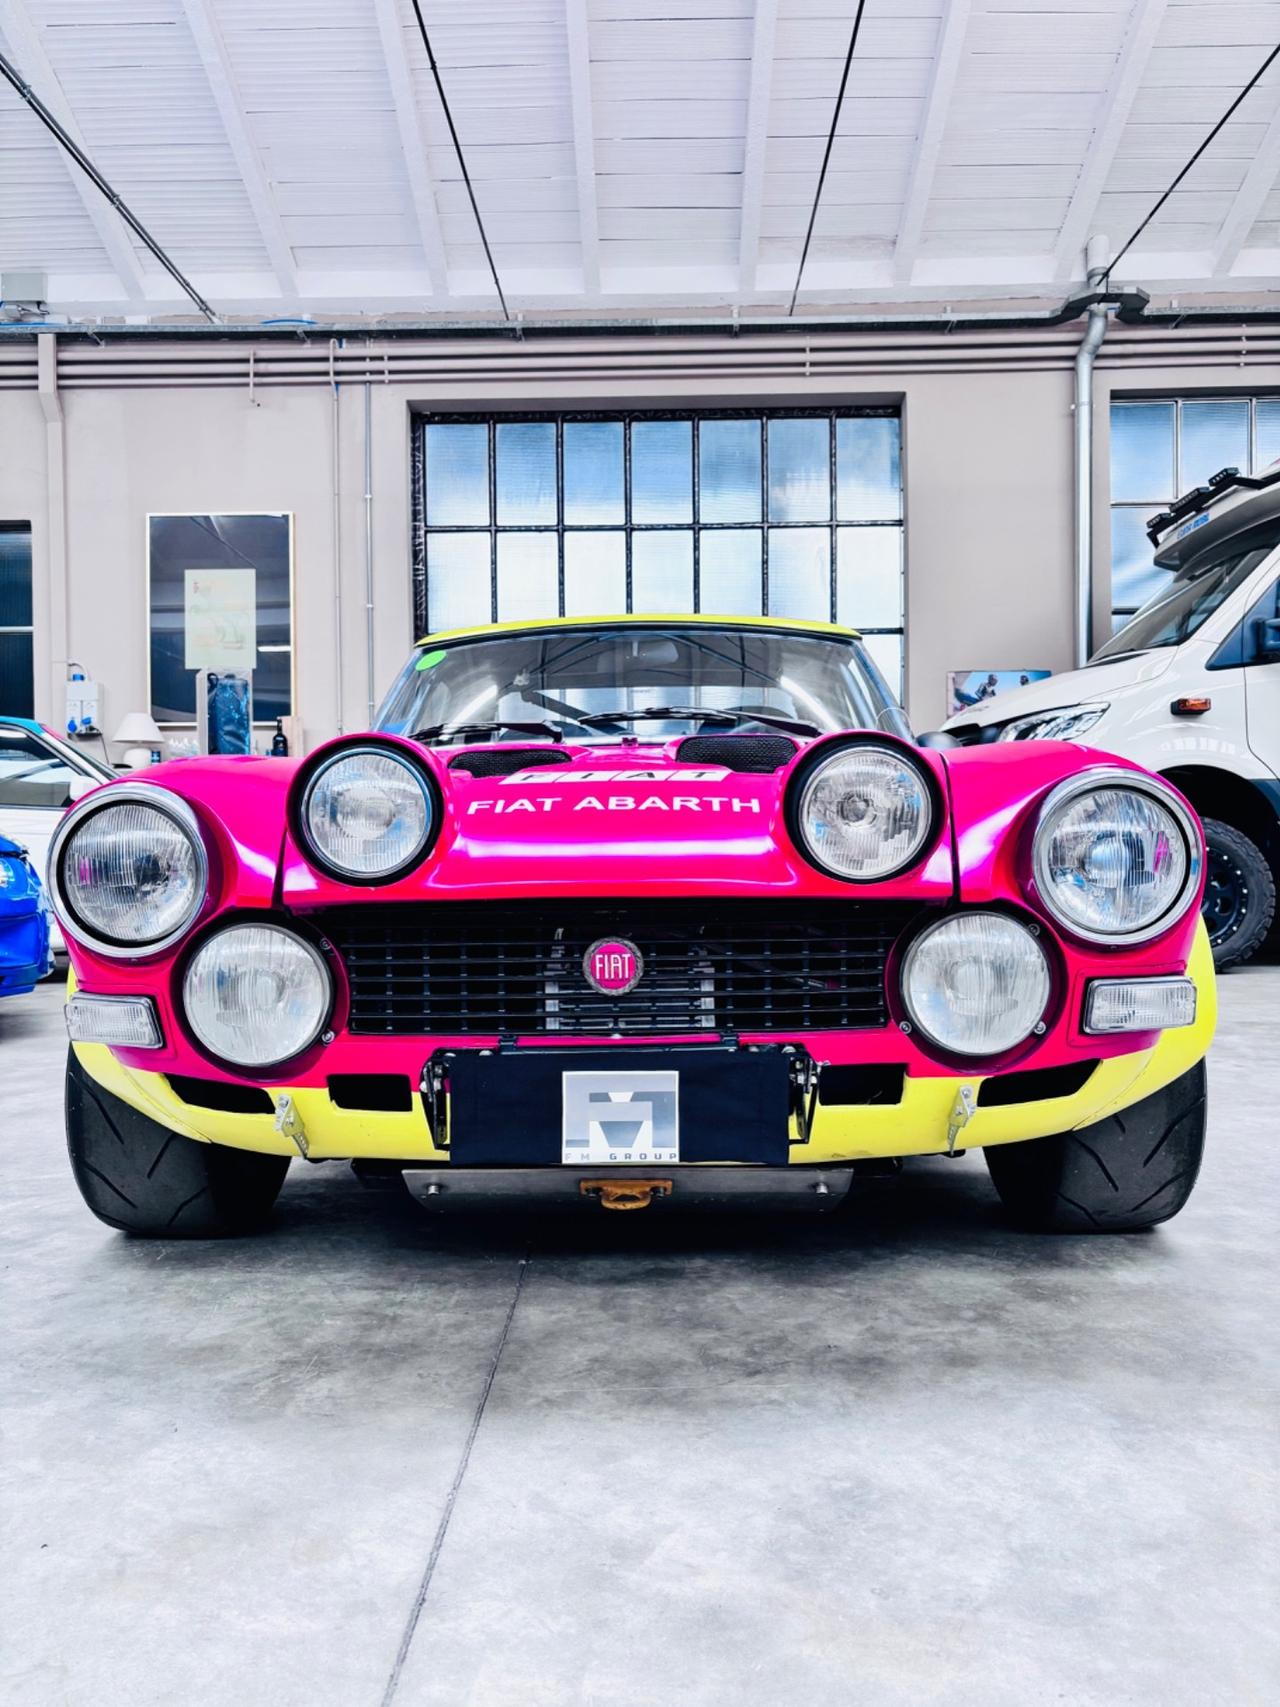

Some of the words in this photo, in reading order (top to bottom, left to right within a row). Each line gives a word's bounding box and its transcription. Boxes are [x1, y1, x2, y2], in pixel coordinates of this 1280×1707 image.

[519, 770, 718, 782] FIAT
[467, 797, 562, 815] FIAT
[573, 795, 761, 813] ABARTH
[595, 953, 632, 980] FIAT
[564, 1152, 590, 1161] FM
[609, 1152, 677, 1161] GROUP
